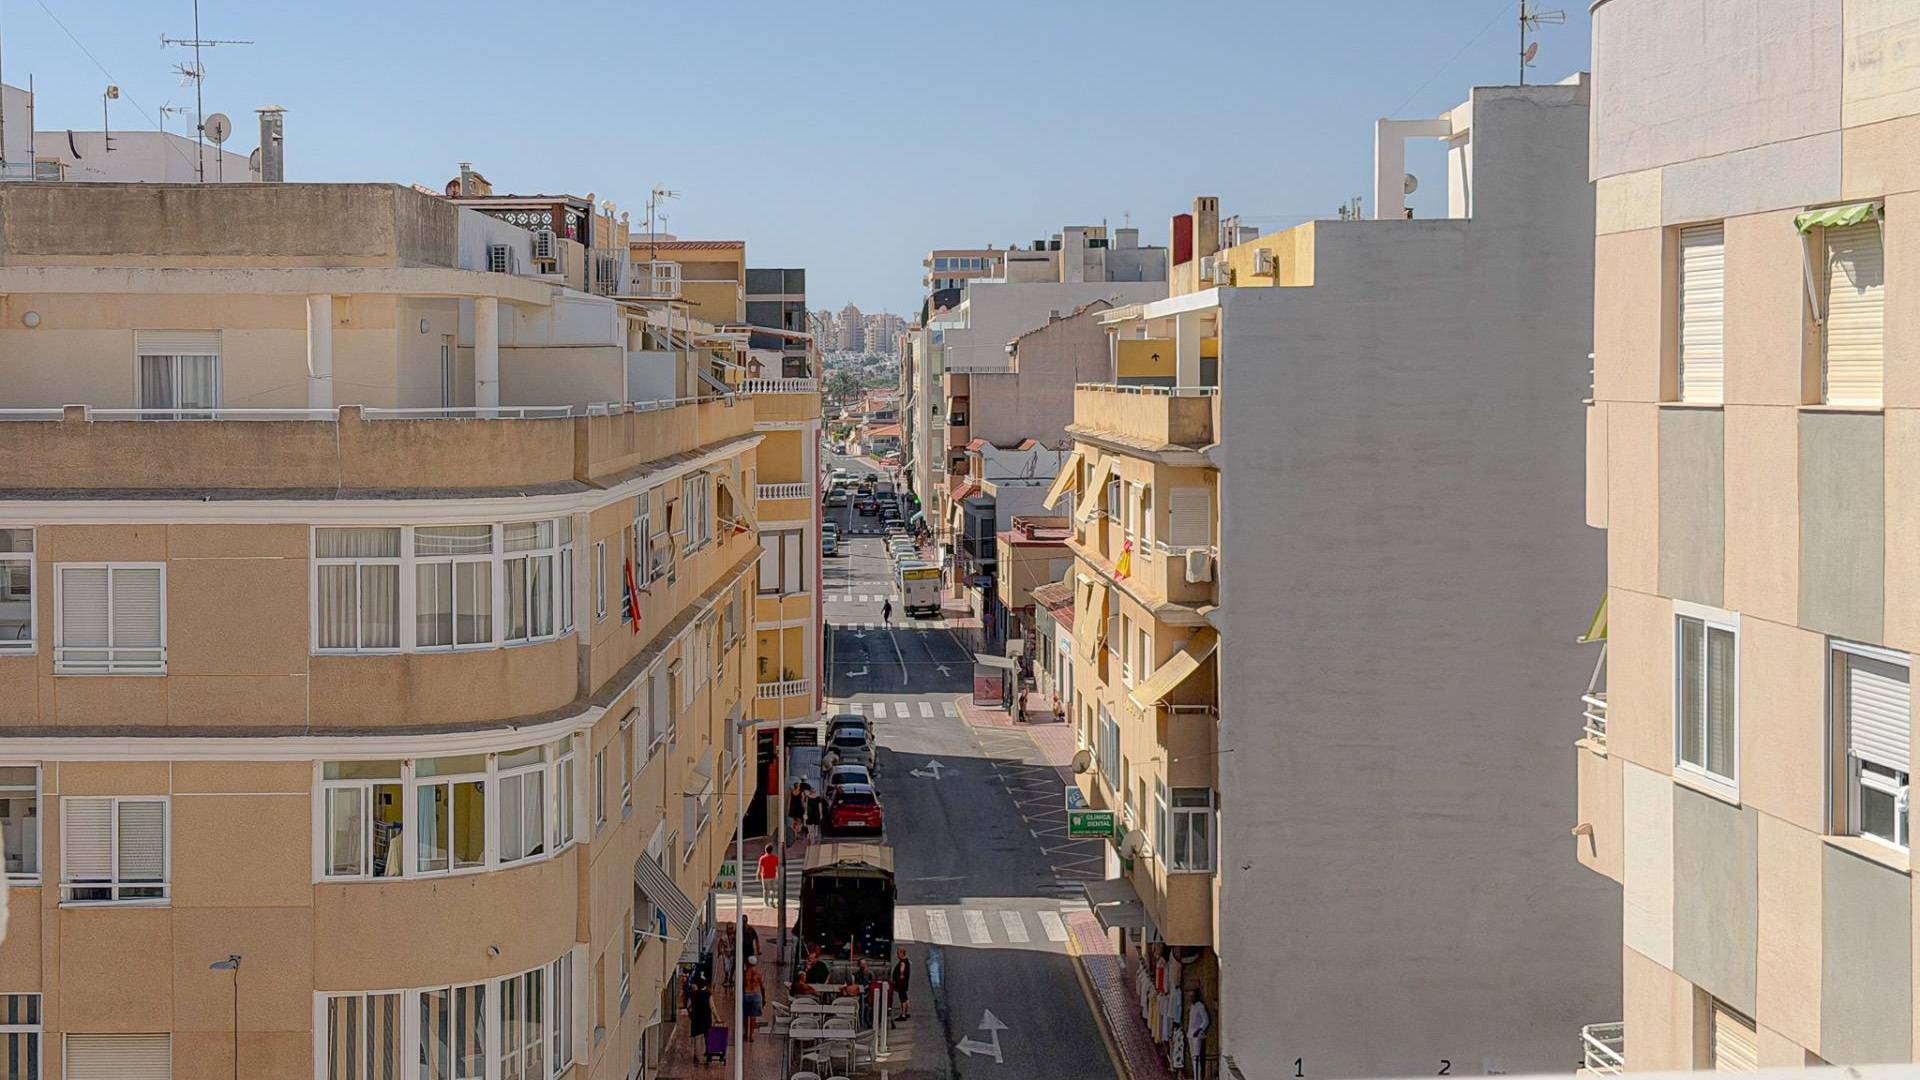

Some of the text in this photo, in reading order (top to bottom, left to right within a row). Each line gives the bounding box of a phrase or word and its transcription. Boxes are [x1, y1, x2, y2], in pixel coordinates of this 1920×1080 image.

[717, 864, 736, 876] RIA
[1294, 1057, 1305, 1078] 1
[1438, 1059, 1451, 1076] 2
